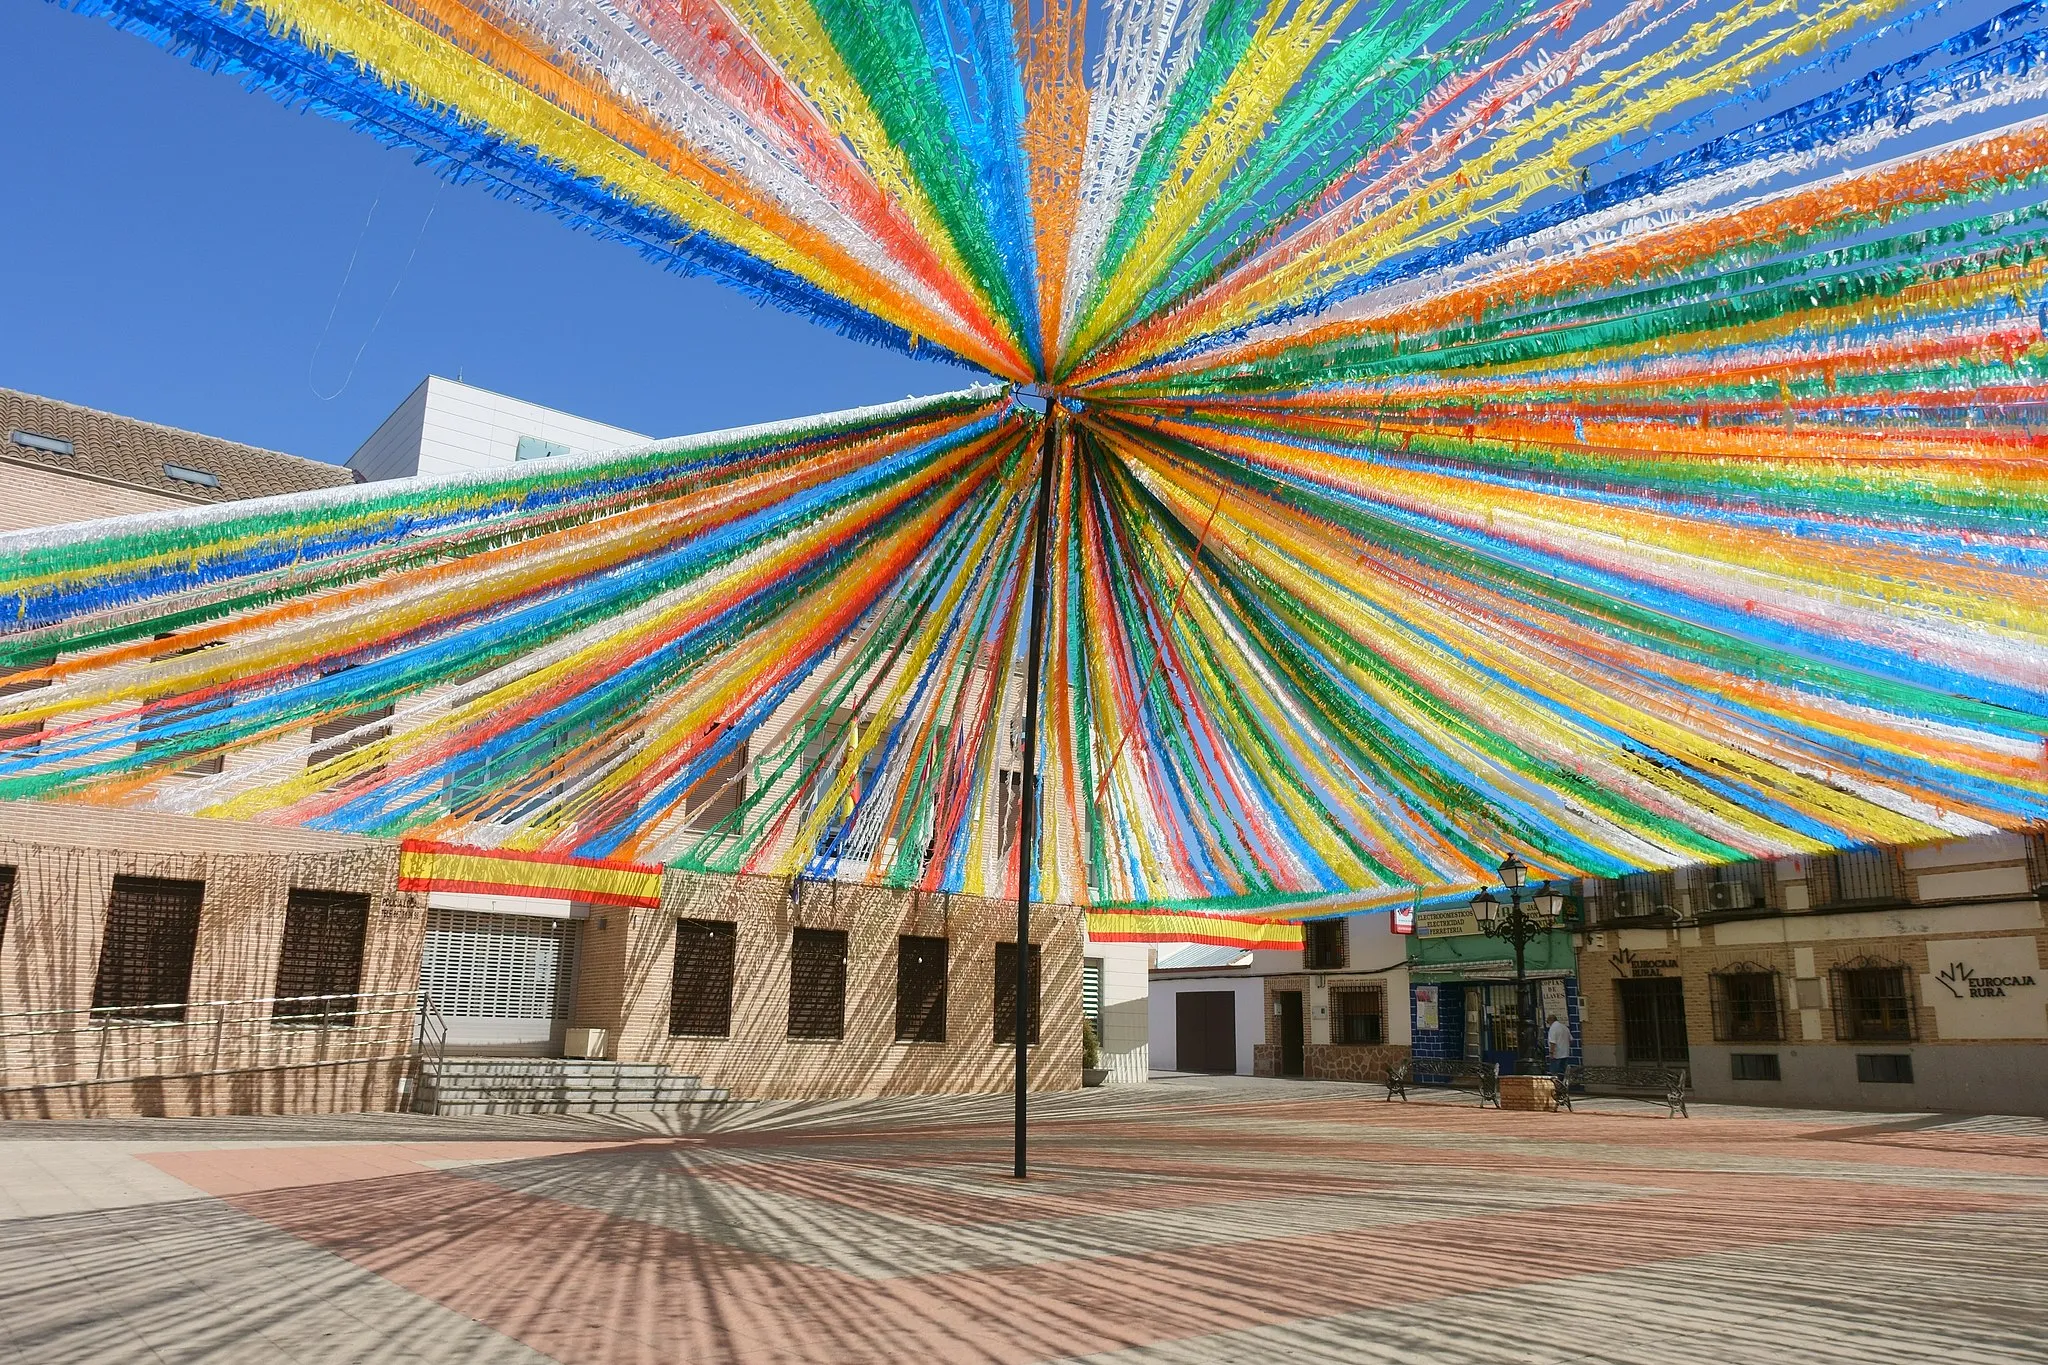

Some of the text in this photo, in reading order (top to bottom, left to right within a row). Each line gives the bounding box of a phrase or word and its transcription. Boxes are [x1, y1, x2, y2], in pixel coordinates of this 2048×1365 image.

[1427, 918, 1465, 928] ELECTRICIDAD
[1631, 959, 1679, 969] EUROCAJA
[1632, 968, 1663, 977] RURAL
[1968, 976, 2036, 987] EUROCAJA
[1970, 987, 2006, 998] RURA
